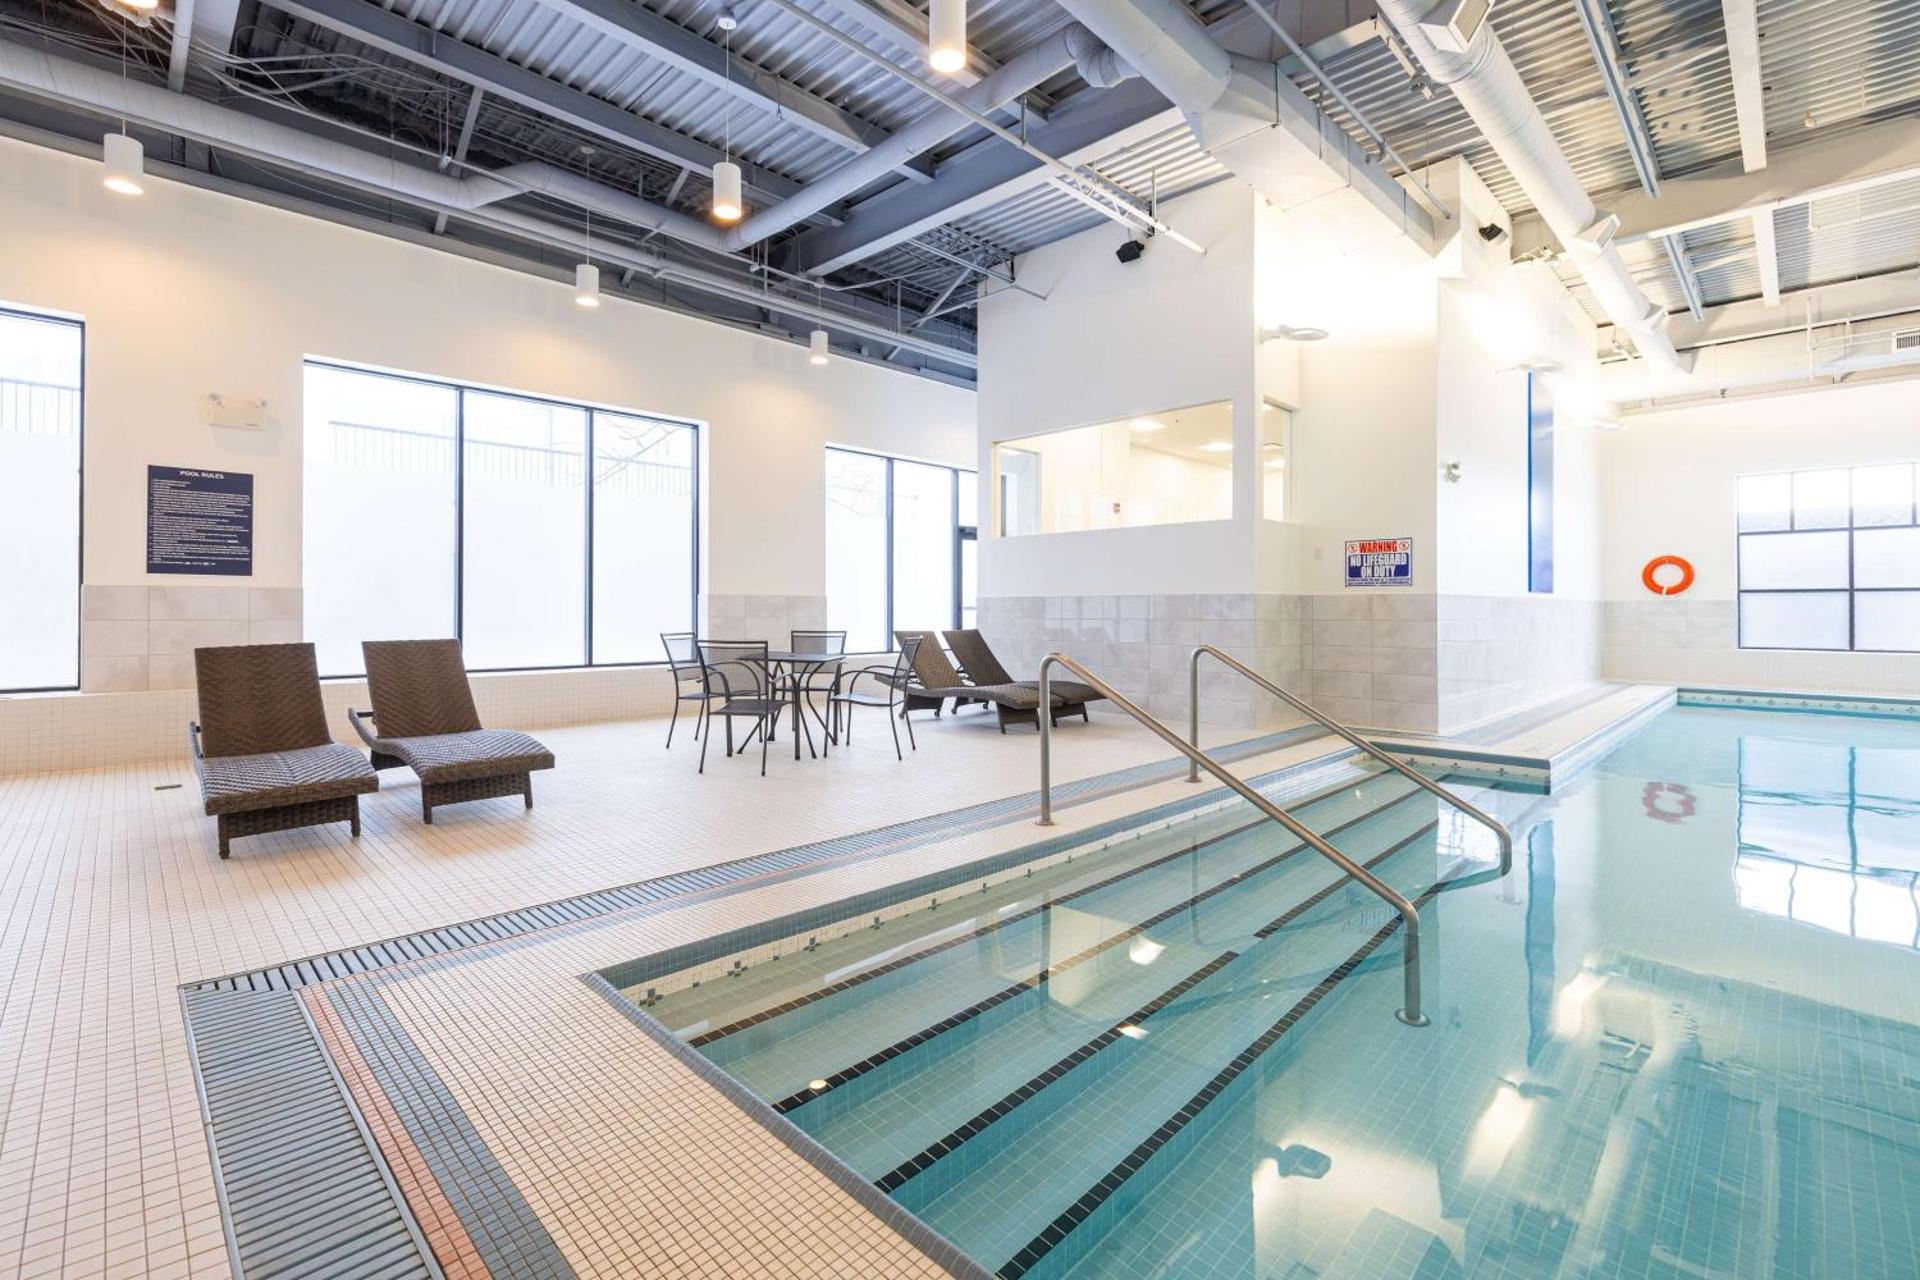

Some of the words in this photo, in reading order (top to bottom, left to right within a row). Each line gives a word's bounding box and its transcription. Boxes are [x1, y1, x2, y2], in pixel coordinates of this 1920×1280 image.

[1360, 541, 1398, 553] WARNING
[1350, 555, 1361, 567] NO
[1363, 553, 1407, 566] LIFEGUARD
[1361, 566, 1372, 577] ON
[1373, 565, 1396, 577] DUTY
